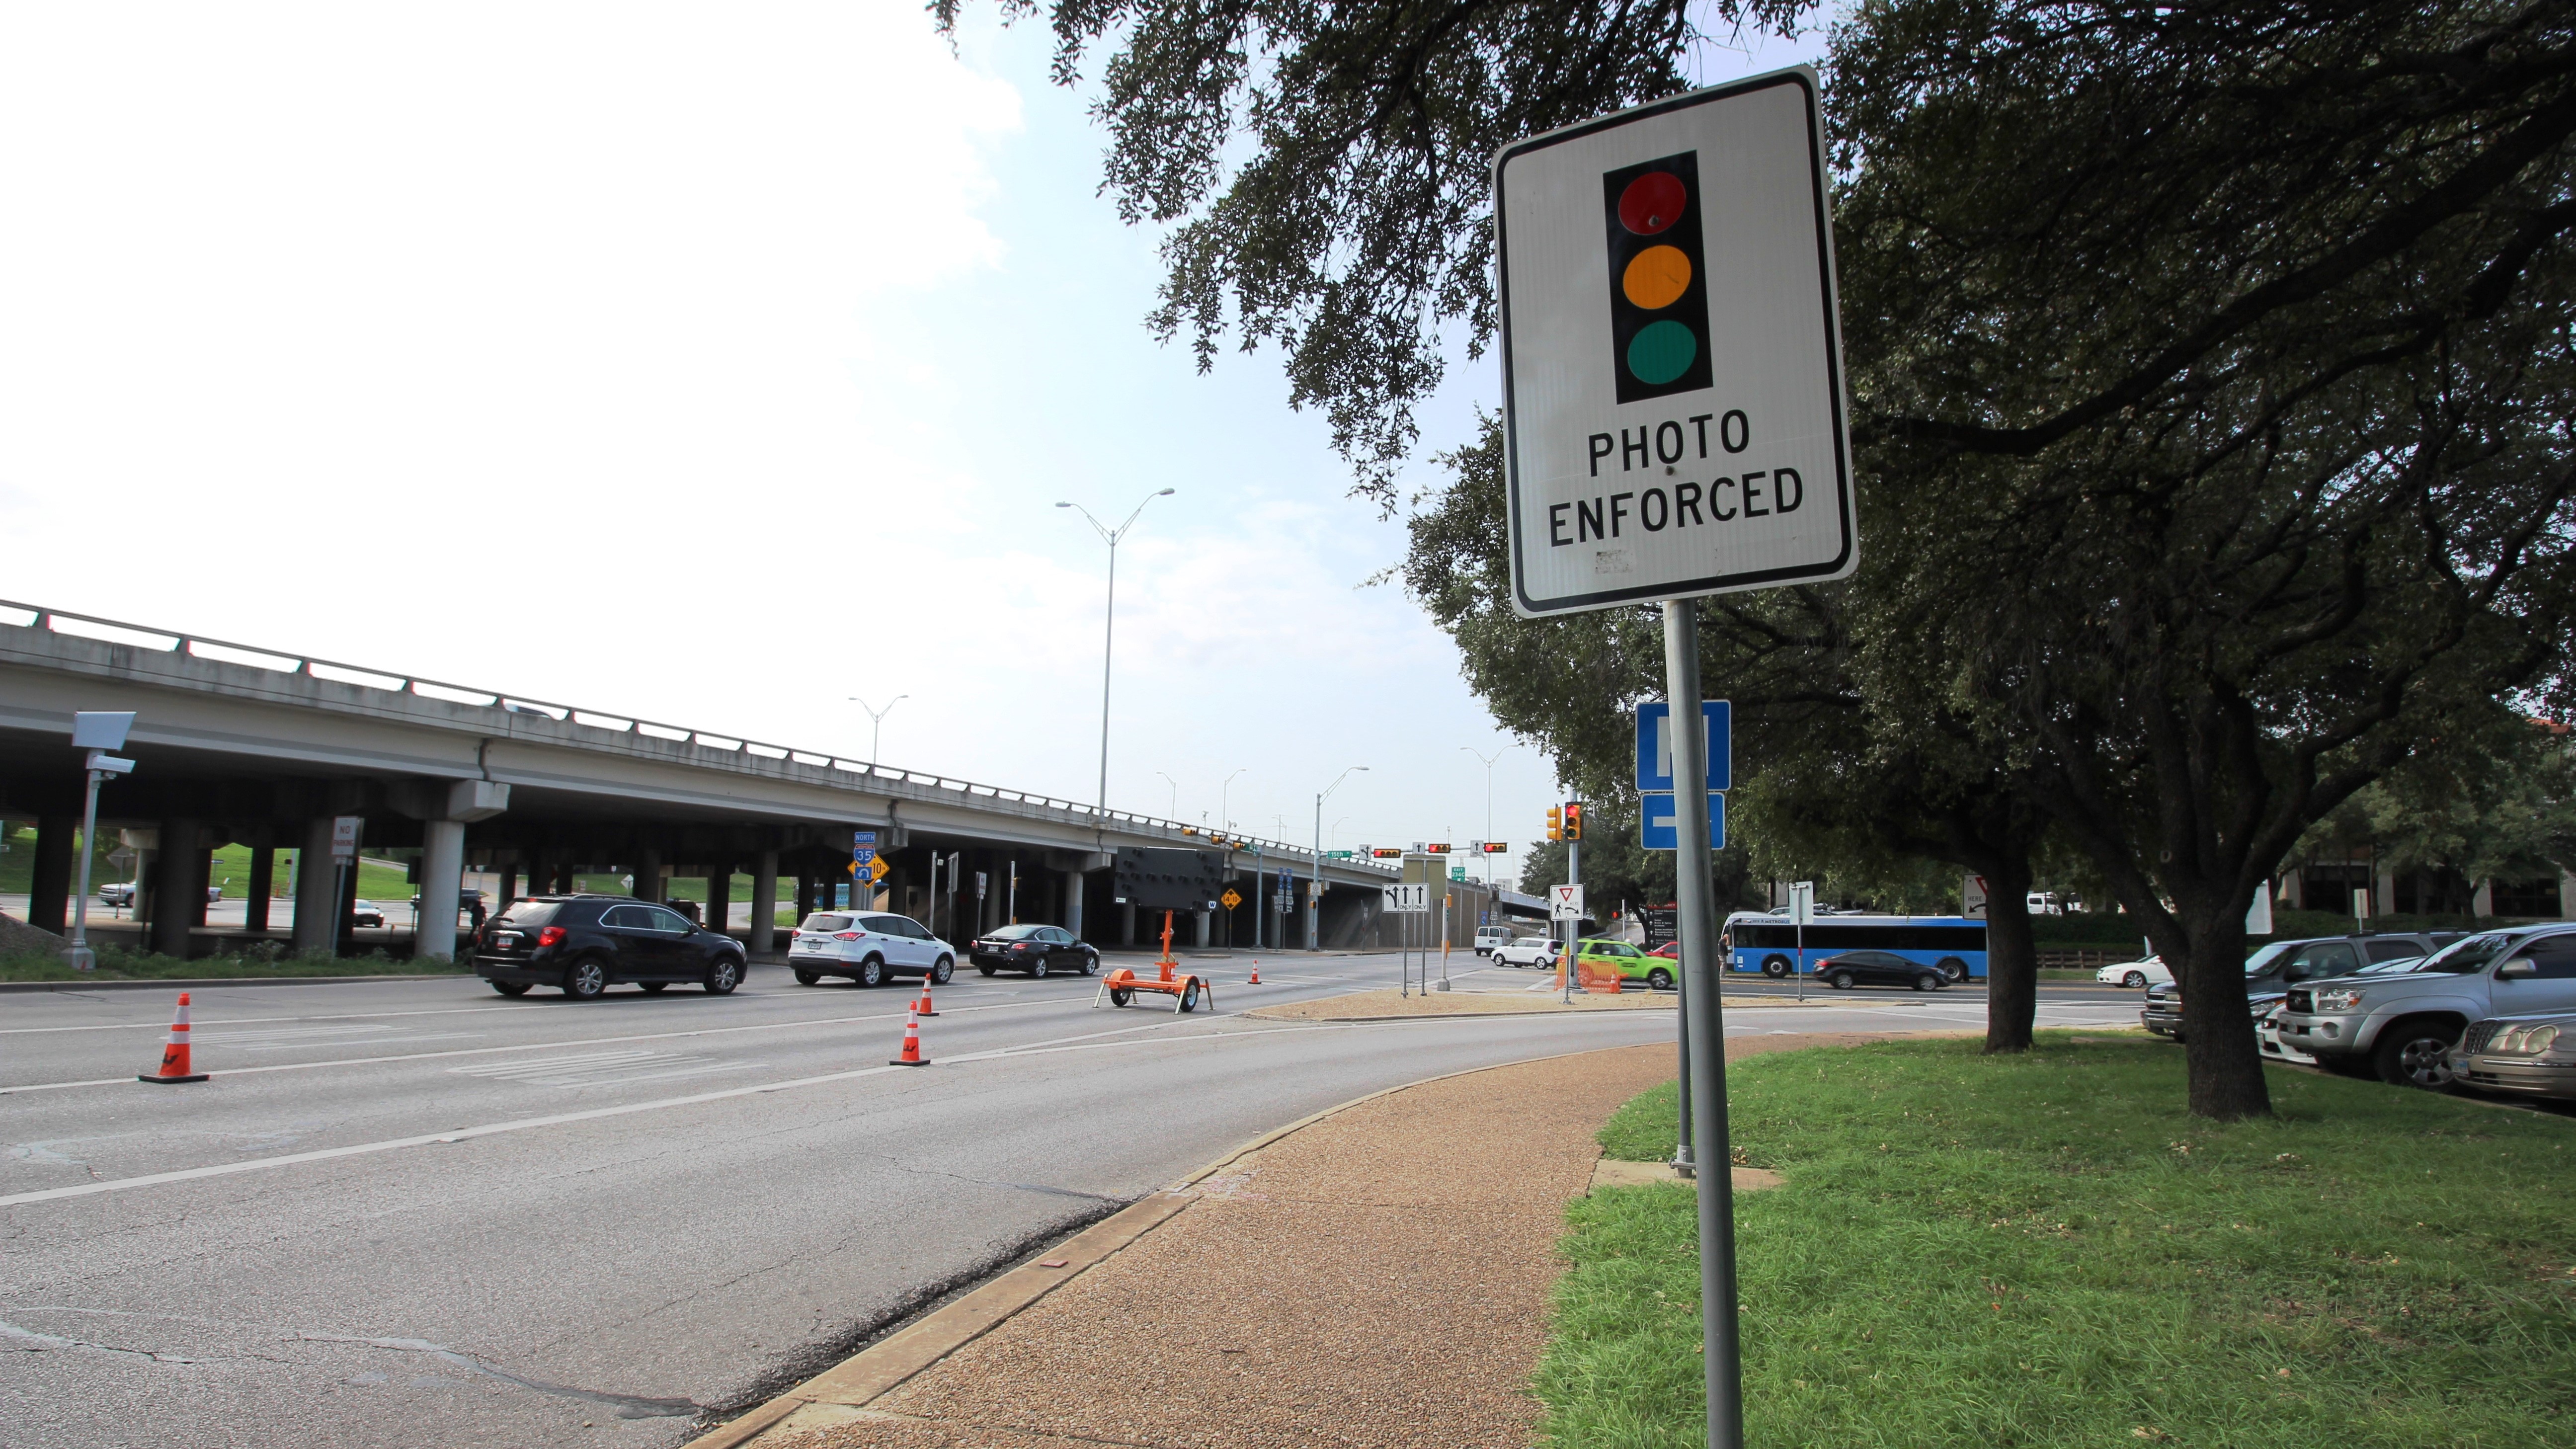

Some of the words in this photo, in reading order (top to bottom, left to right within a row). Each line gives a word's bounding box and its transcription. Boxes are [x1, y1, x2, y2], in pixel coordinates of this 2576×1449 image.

[1588, 409, 1750, 478] PHOTO
[1549, 467, 1803, 547] ENFORCED
[339, 825, 350, 834] NO
[857, 850, 872, 861] 35
[873, 863, 882, 874] 10
